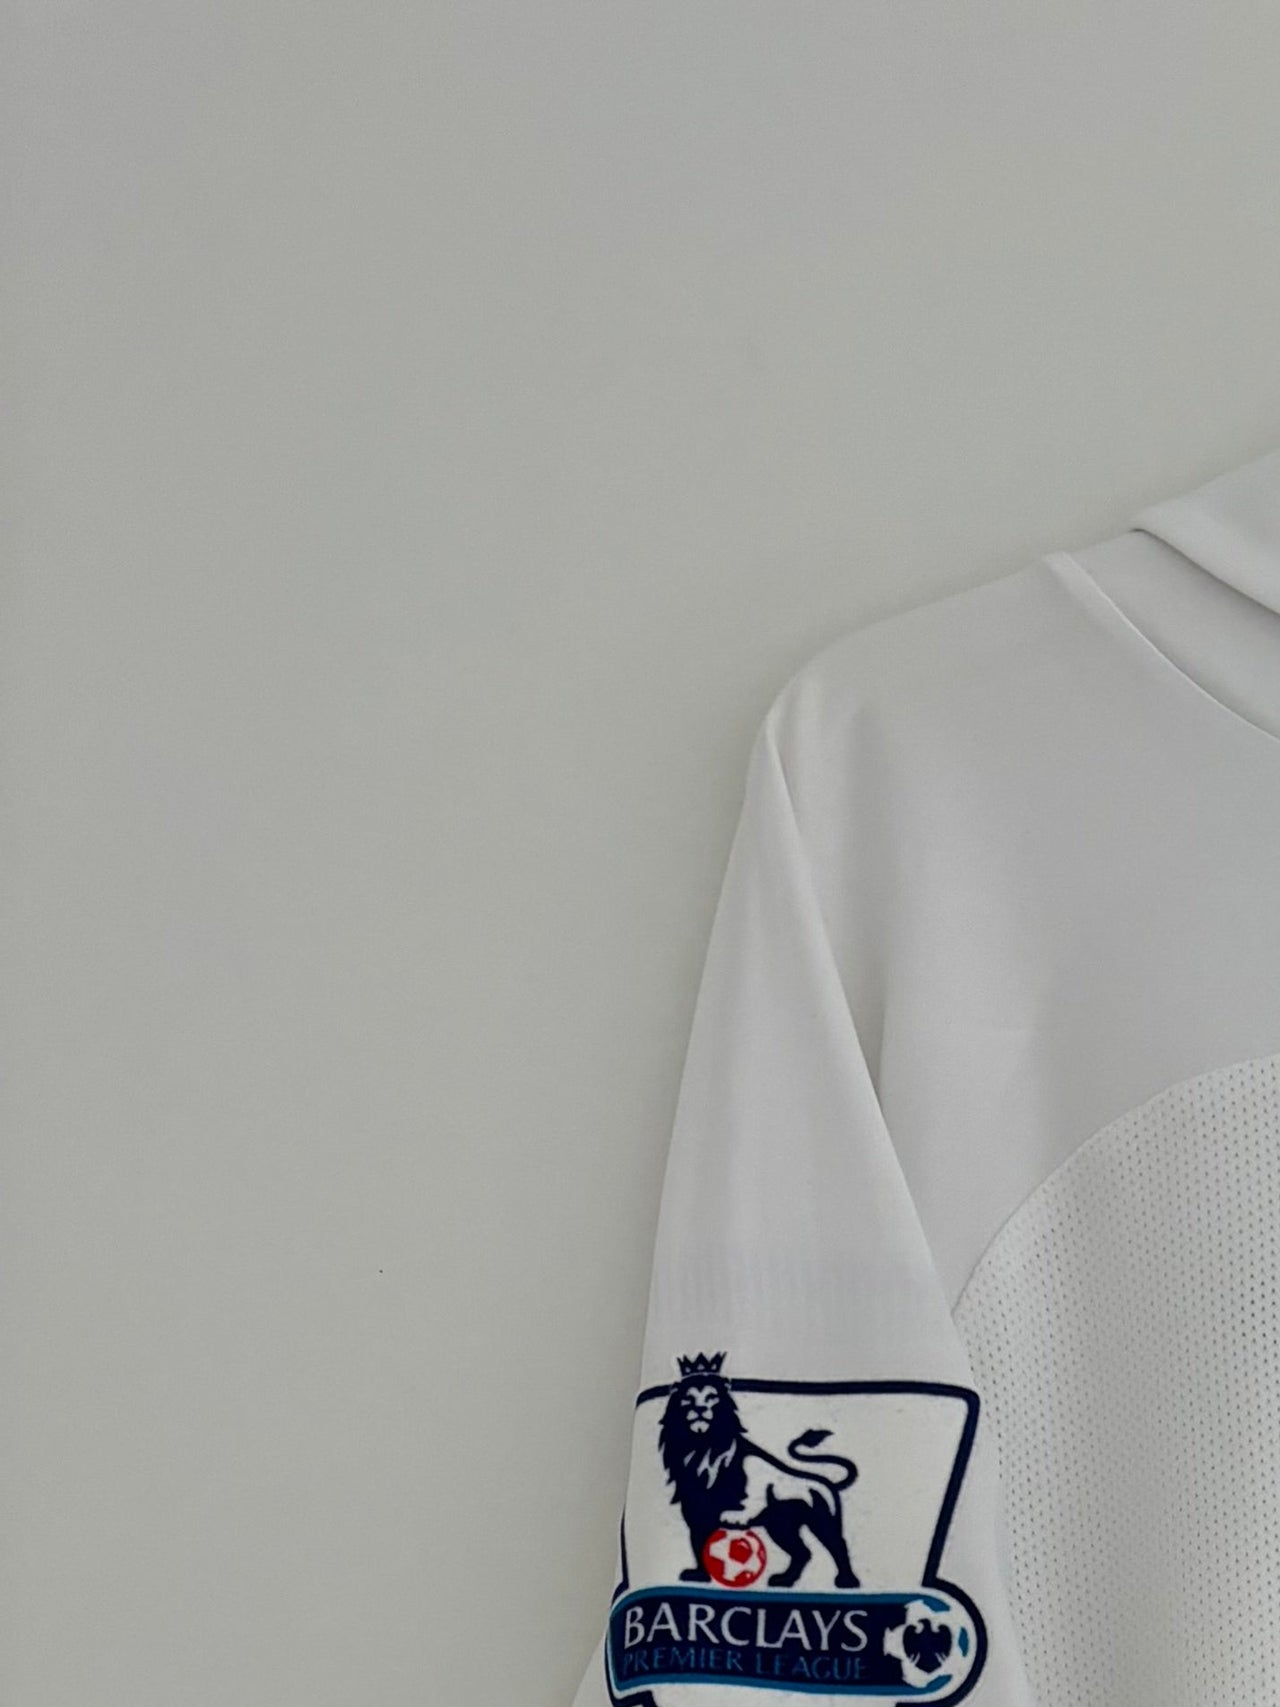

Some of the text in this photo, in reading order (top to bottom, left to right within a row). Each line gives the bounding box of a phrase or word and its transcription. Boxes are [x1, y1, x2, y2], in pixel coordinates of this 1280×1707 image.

[624, 1601, 869, 1652] BARCLAYS
[622, 1645, 869, 1681] PREMIER LEAGUE
